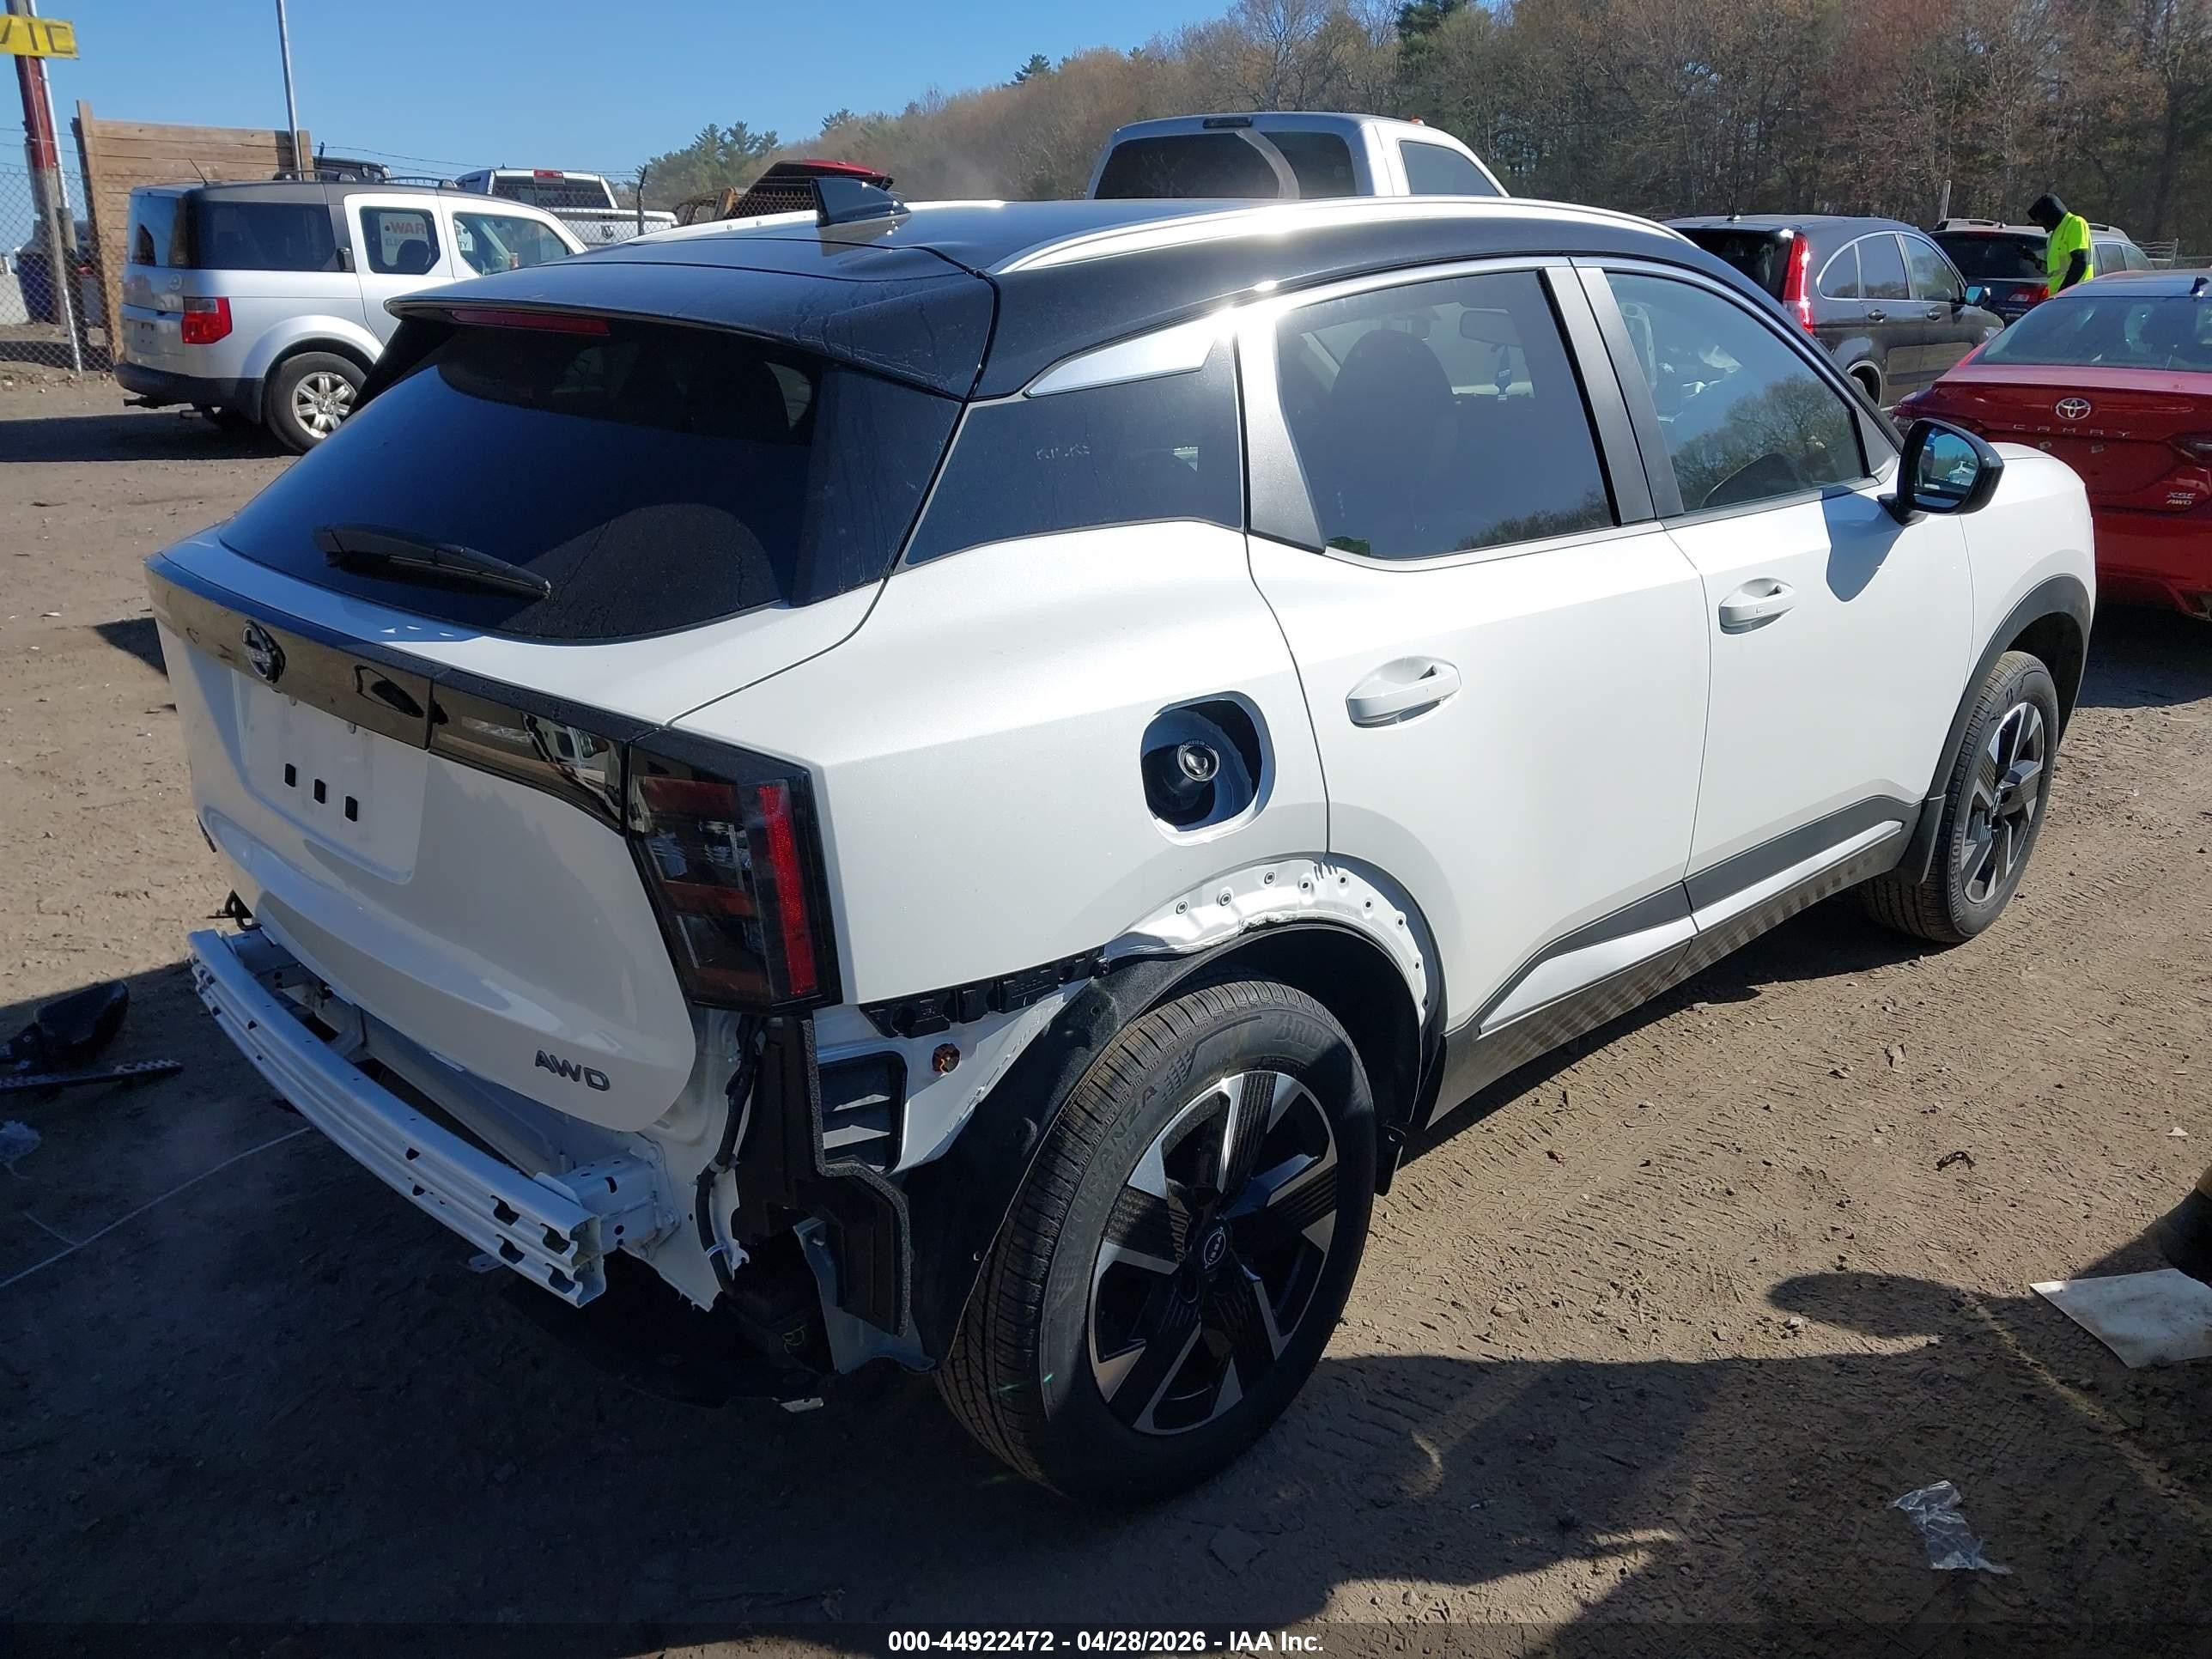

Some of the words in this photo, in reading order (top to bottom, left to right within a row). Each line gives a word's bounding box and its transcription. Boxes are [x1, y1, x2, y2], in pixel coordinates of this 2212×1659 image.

[2013, 424, 2130, 437] CAMRY
[1949, 821, 1965, 922] BRIDGESTONE
[534, 1049, 611, 1091] AWD
